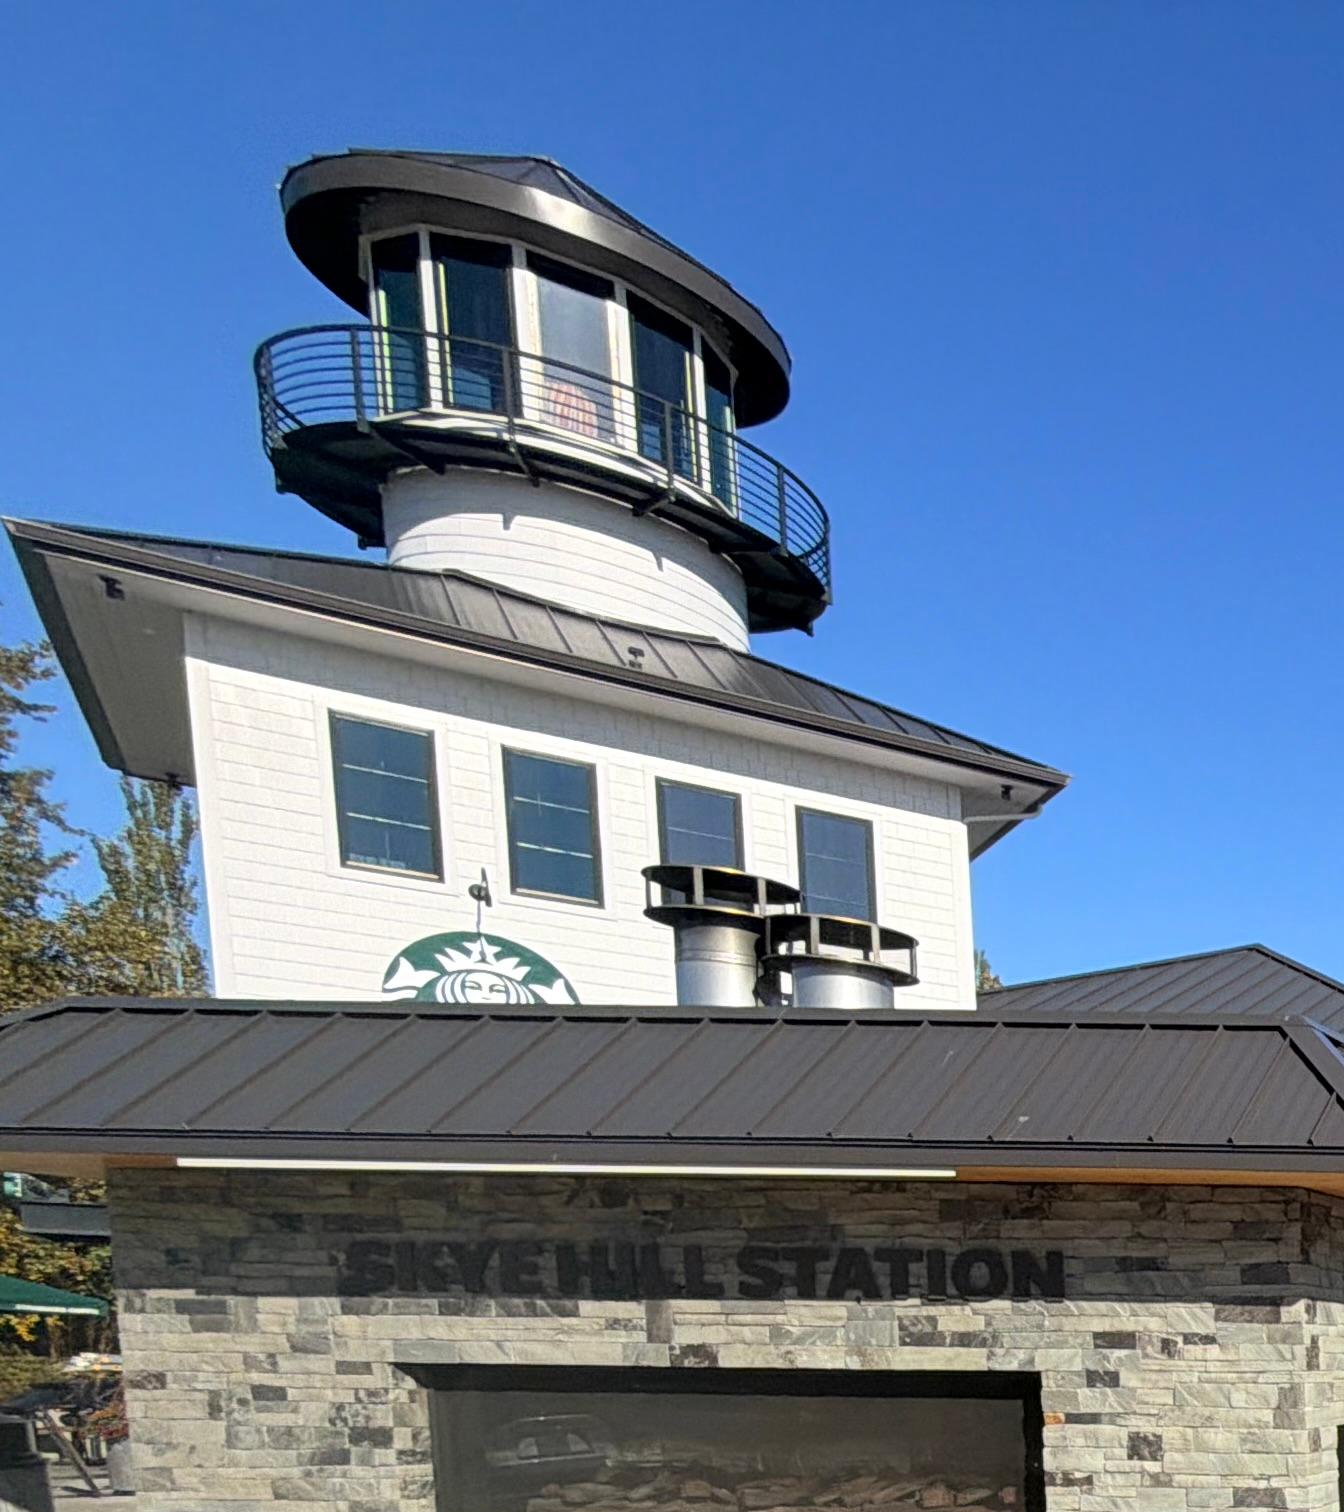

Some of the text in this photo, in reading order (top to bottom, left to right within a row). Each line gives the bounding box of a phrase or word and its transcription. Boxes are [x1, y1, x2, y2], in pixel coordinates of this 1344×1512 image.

[336, 1241, 1066, 1302] SKYE HILL STATION
